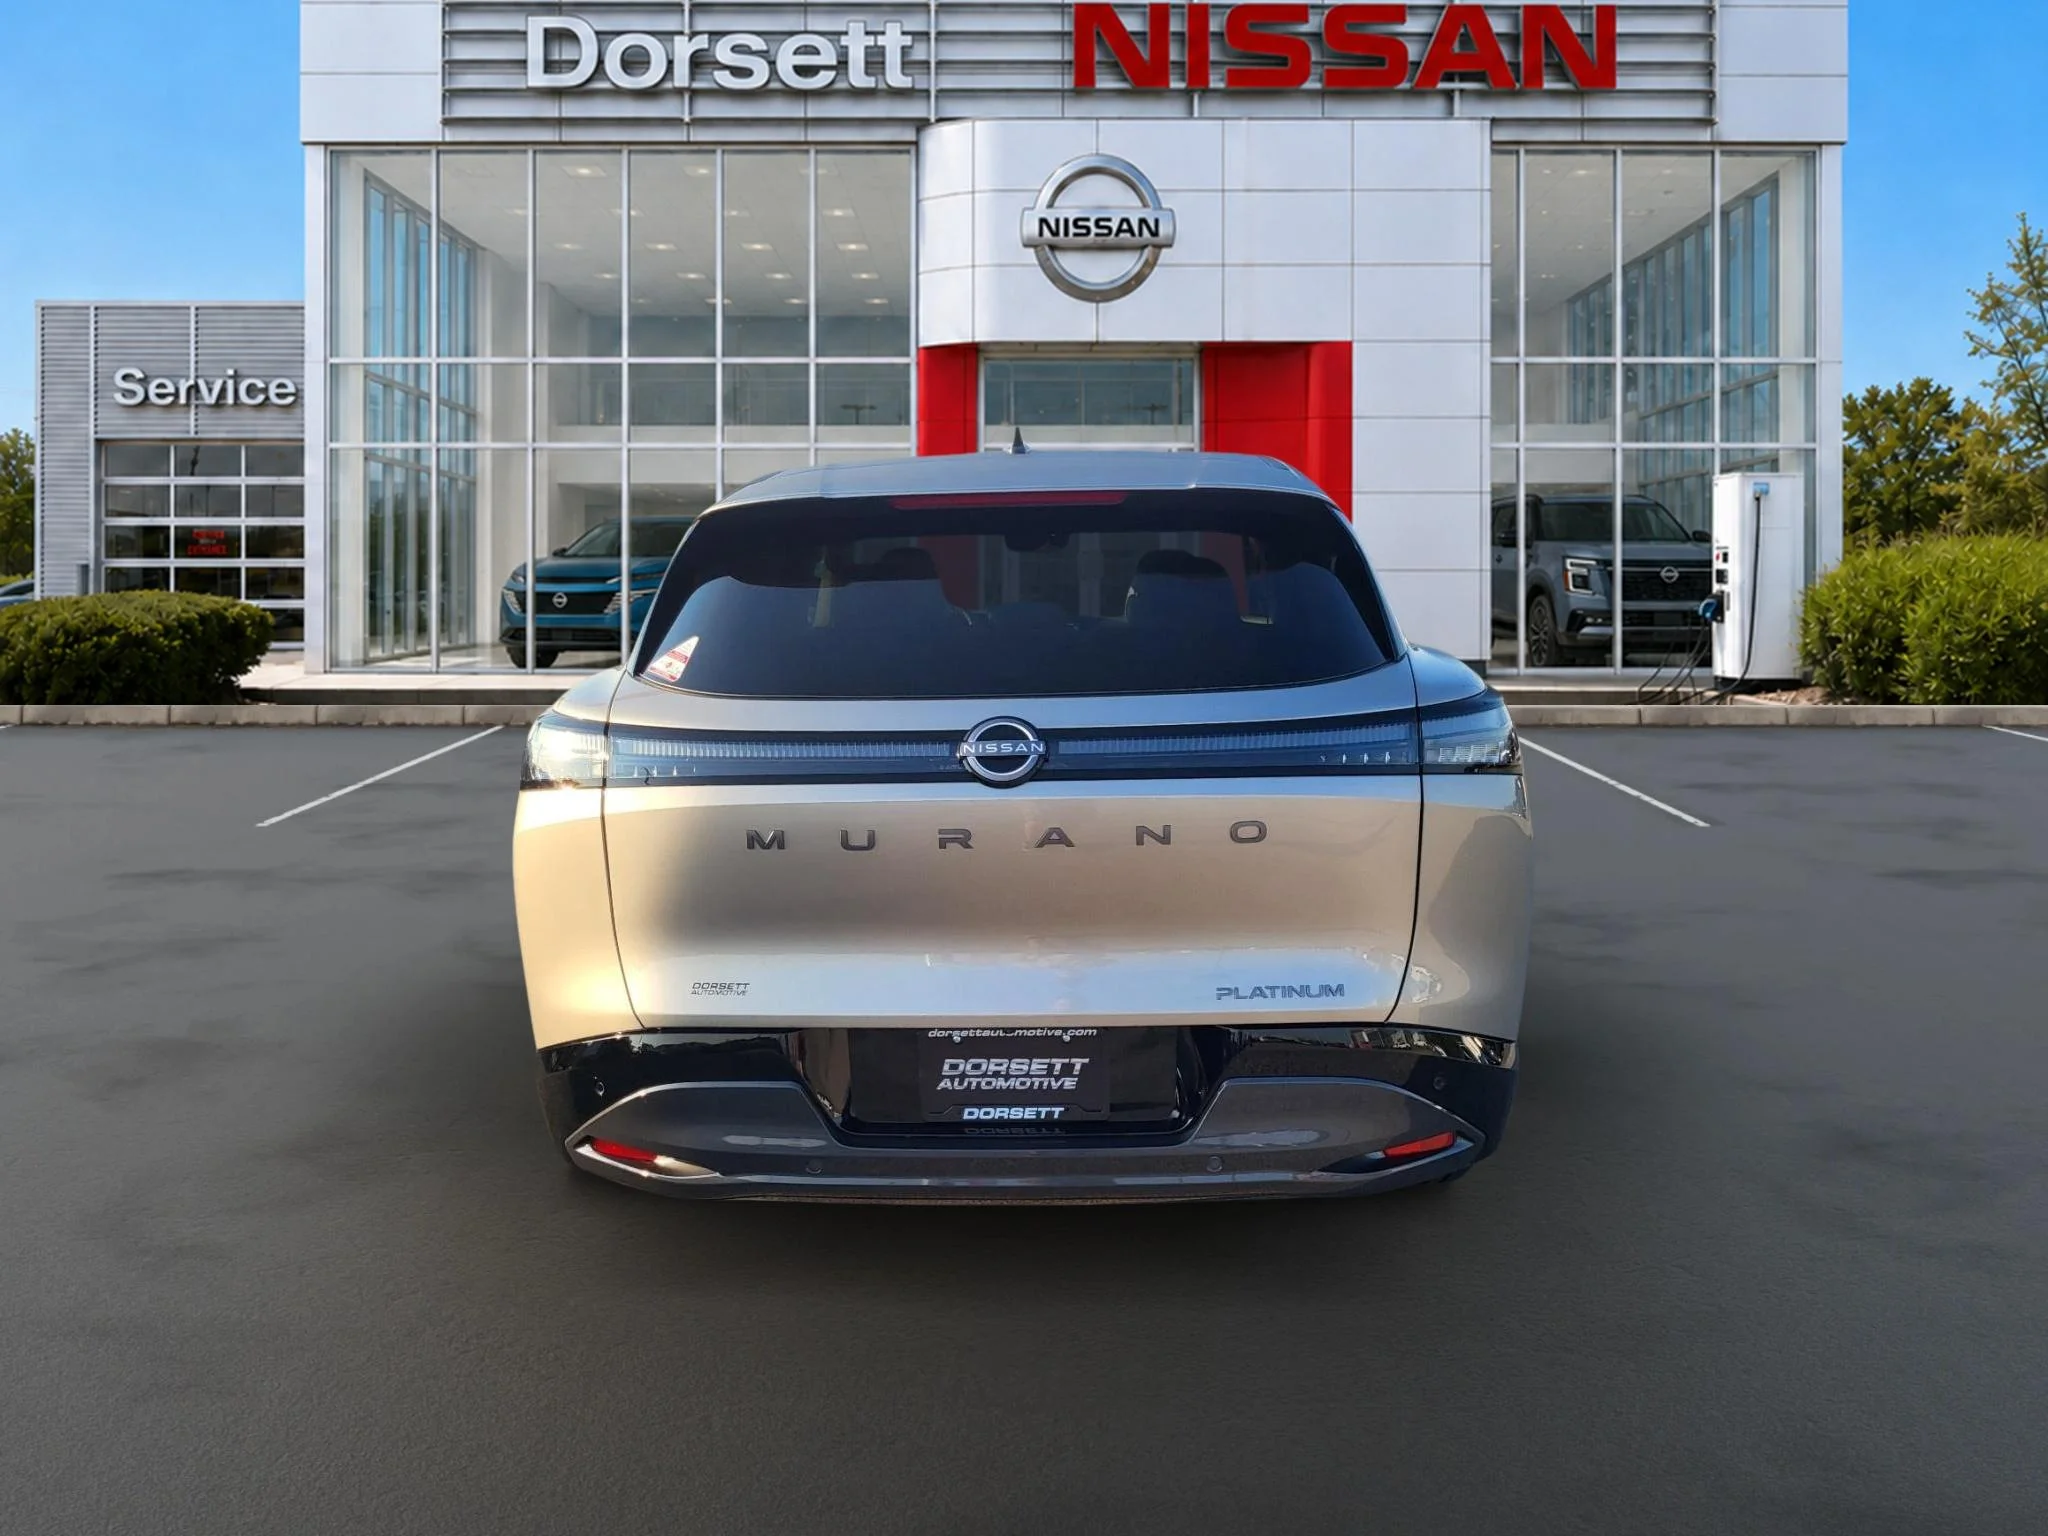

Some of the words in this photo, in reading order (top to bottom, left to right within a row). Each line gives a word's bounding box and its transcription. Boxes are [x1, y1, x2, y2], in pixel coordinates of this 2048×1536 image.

[526, 15, 913, 89] Dorsett
[1073, 4, 1617, 89] NISSAN
[1038, 217, 1160, 238] NISSAN
[113, 367, 297, 406] Service
[963, 743, 1043, 753] NISSAN
[746, 820, 1268, 851] MURANO
[692, 982, 750, 990] DORSETT
[1216, 983, 1345, 1000] PLATINUM
[928, 1028, 1097, 1038] dorsettautmotive.com
[941, 1058, 1090, 1076] DORSETT
[936, 1077, 1078, 1090] AUTOMOTIVE
[962, 1107, 1065, 1120] DORSETT
